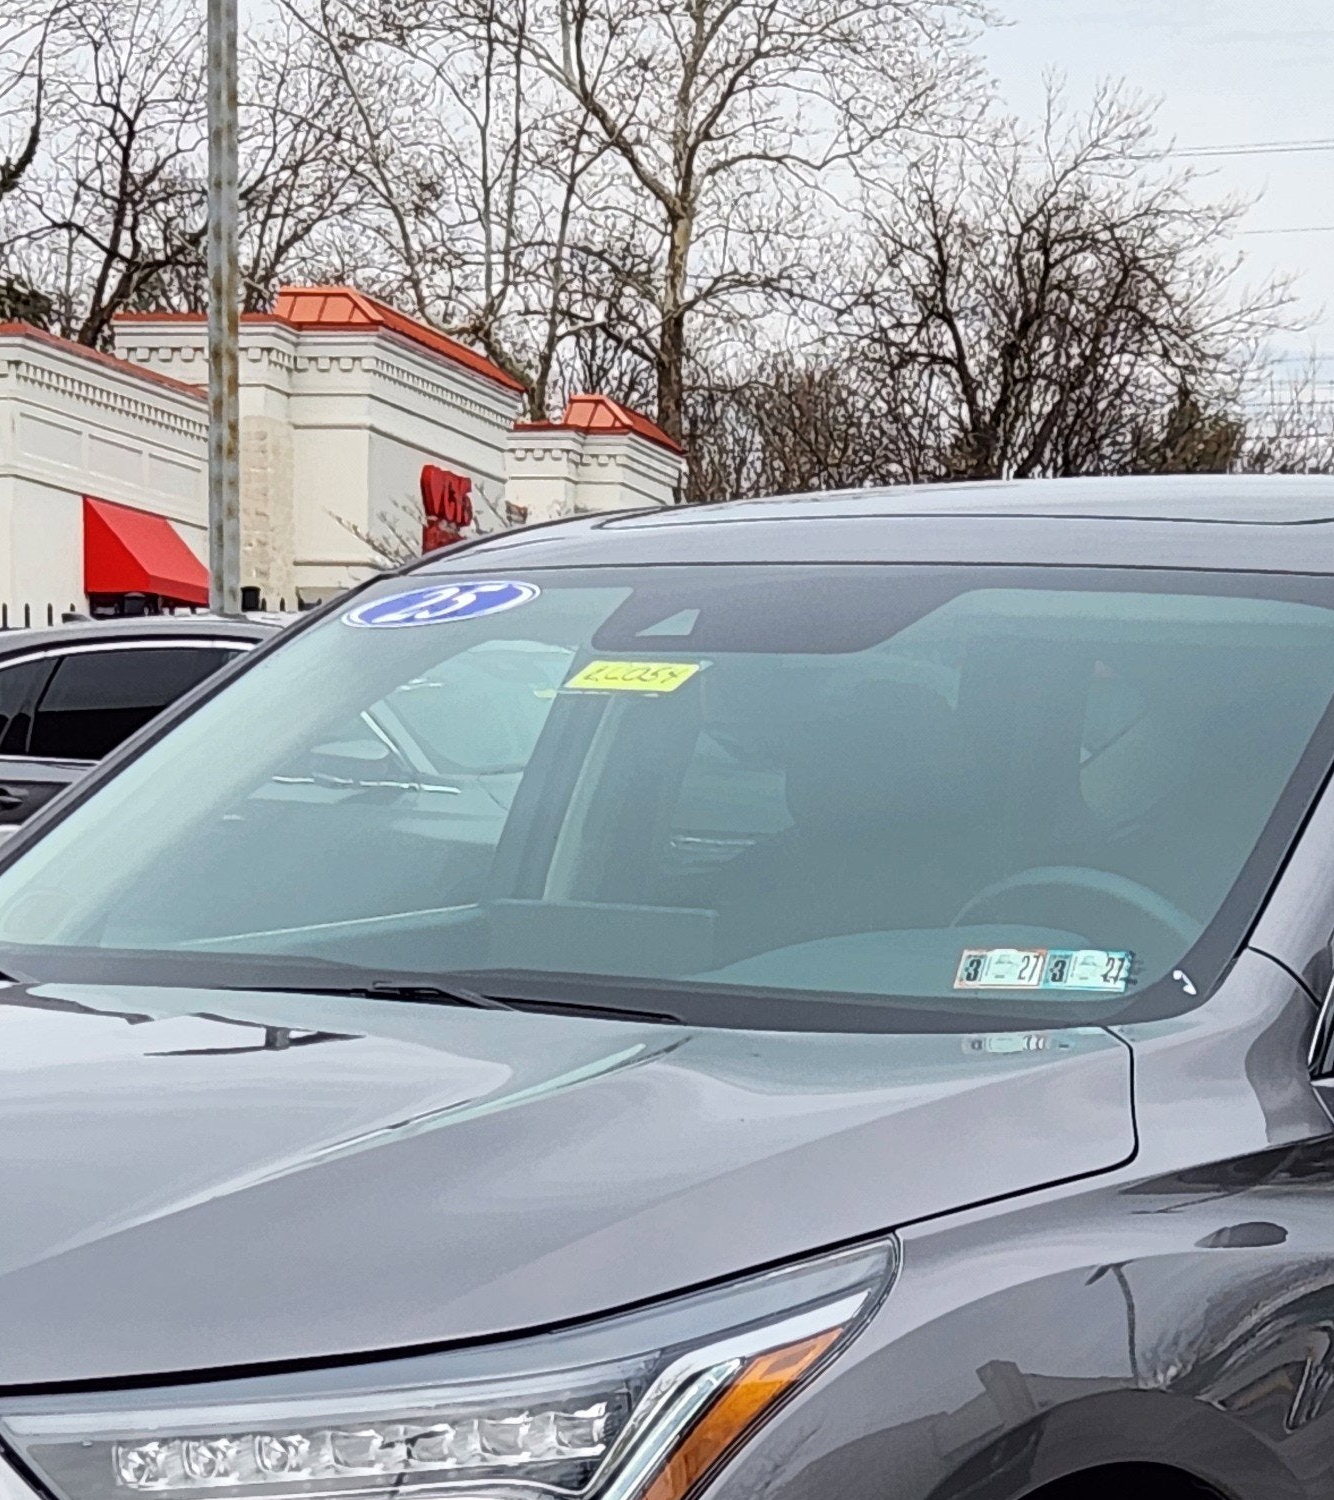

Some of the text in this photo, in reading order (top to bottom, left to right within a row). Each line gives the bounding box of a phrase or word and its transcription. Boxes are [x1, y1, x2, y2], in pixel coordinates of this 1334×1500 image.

[442, 470, 473, 527] CVS
[371, 583, 509, 624] 25
[965, 955, 1041, 983] 3 27
[1049, 959, 1067, 983] 3
